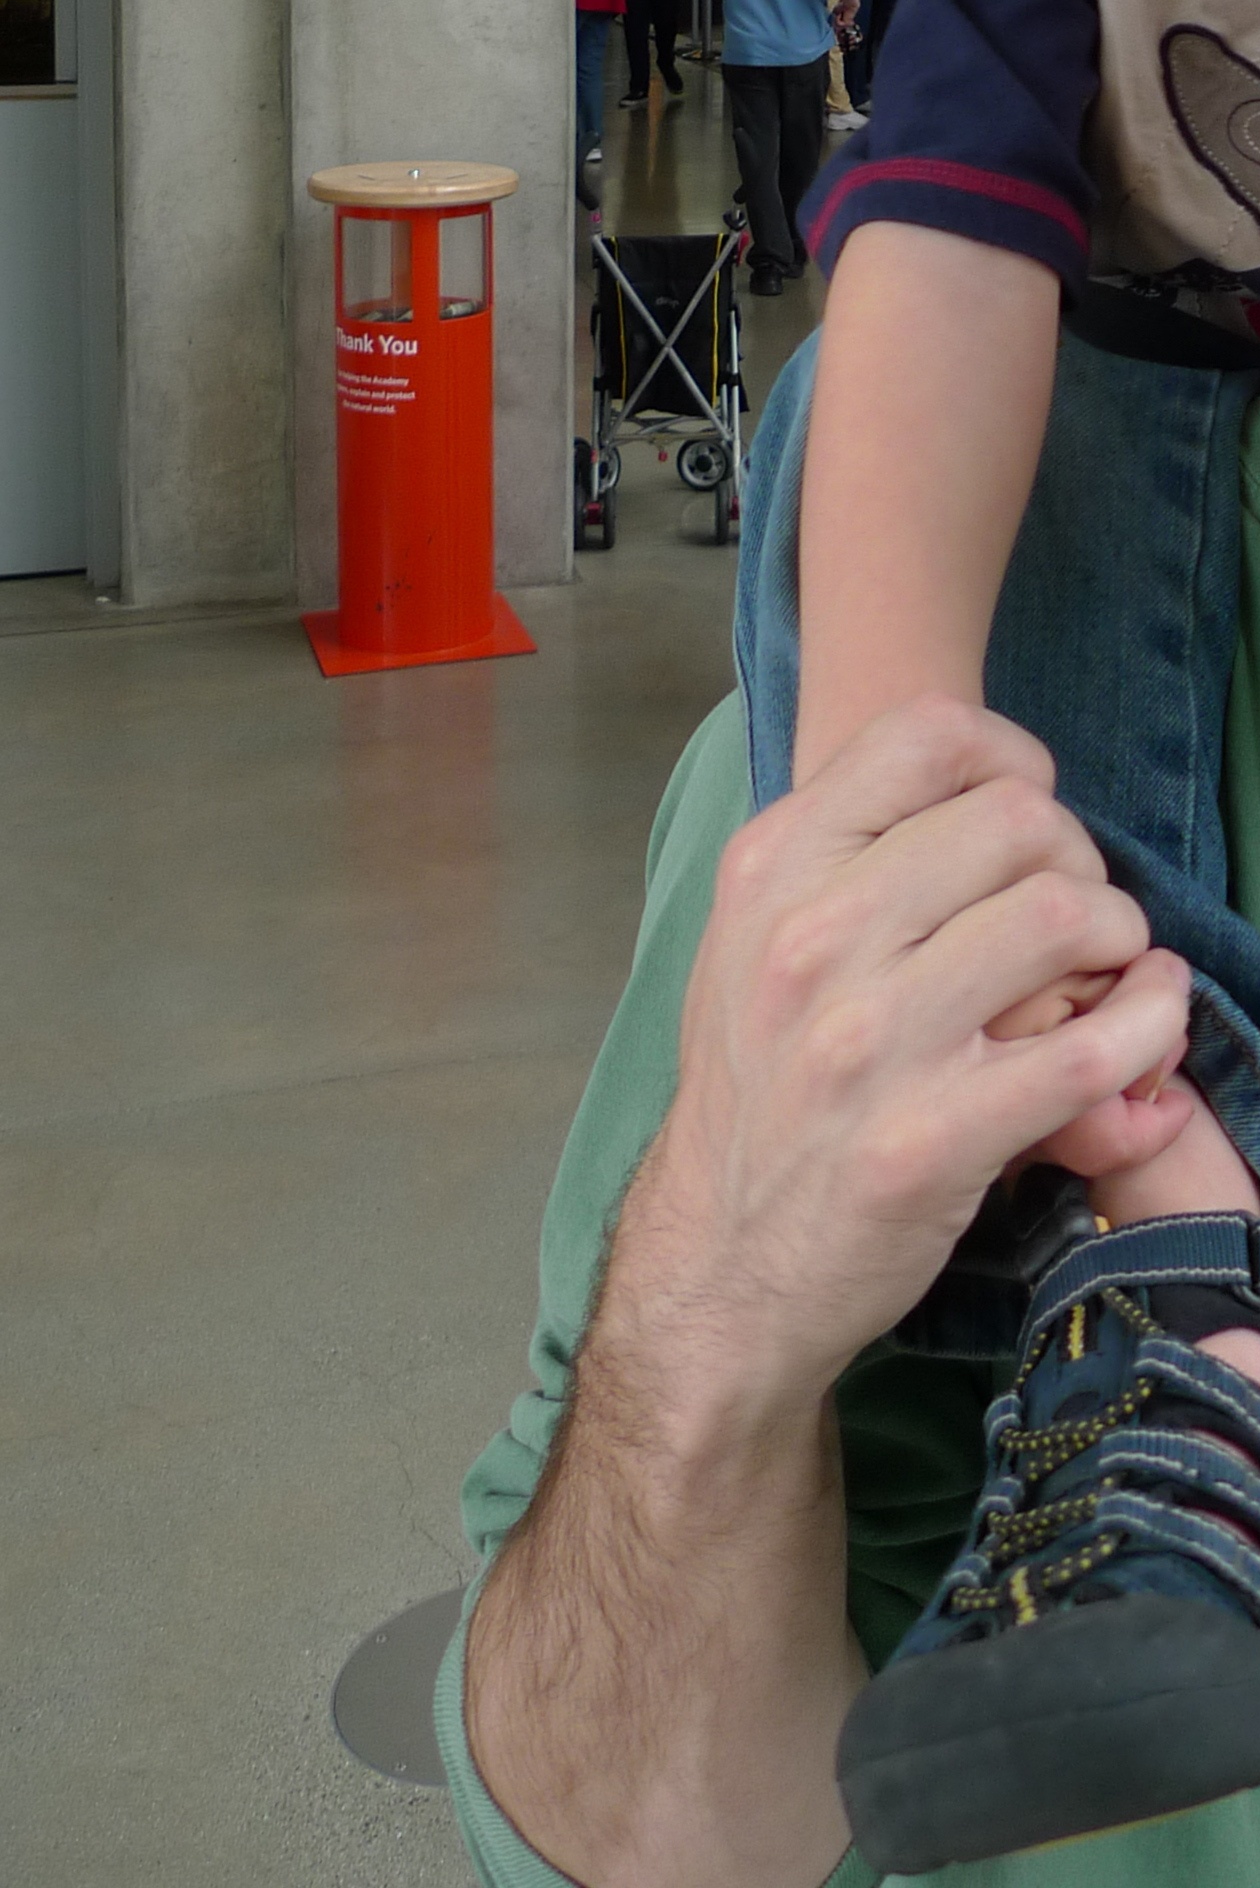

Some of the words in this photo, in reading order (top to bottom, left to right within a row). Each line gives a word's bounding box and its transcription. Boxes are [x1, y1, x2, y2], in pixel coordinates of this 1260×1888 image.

[336, 327, 374, 353] Thank
[378, 334, 418, 355] You
[373, 376, 409, 387] Academy
[387, 391, 415, 401] protect
